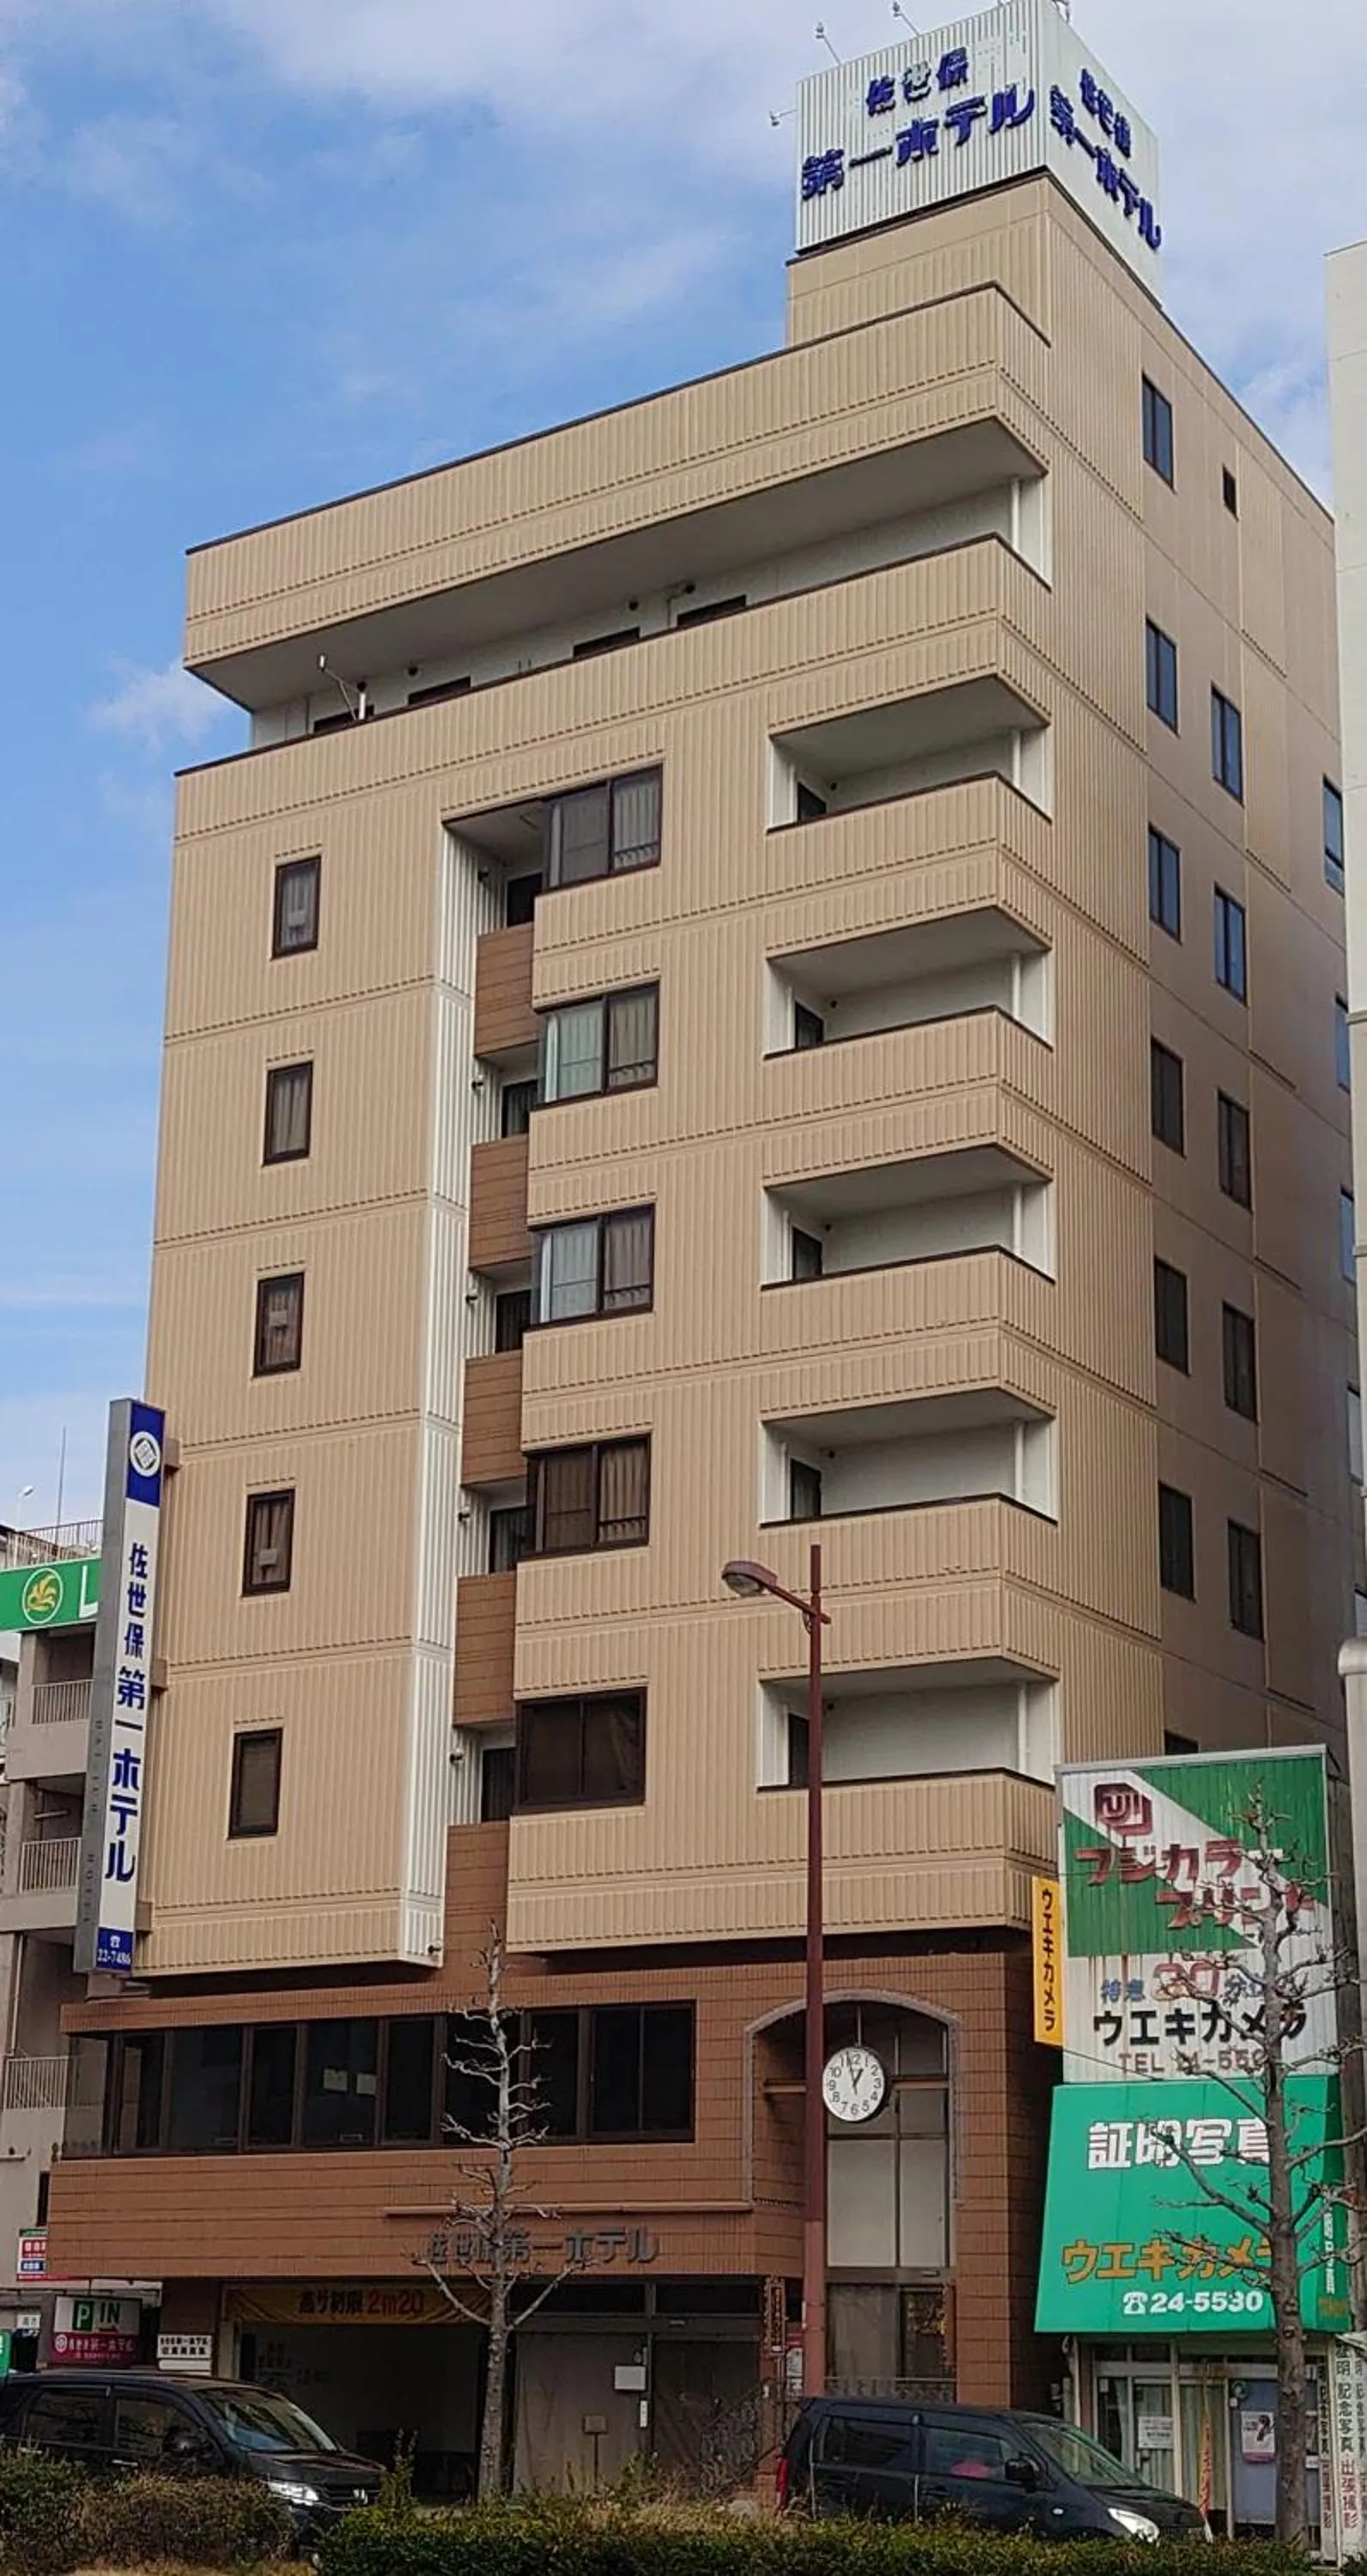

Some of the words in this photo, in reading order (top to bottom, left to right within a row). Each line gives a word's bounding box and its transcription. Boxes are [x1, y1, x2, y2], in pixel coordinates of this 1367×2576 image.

[801, 83, 1036, 201] 第一ホテル
[105, 1542, 148, 1883] 佐世保第一ホテル
[1042, 1888, 1055, 2032] ウエキカメラ
[1119, 2052, 1164, 2072] TEL
[841, 2101, 848, 2113] 7
[76, 2301, 89, 2329] P
[100, 2302, 120, 2324] IN
[1150, 2291, 1264, 2313] 24-5530
